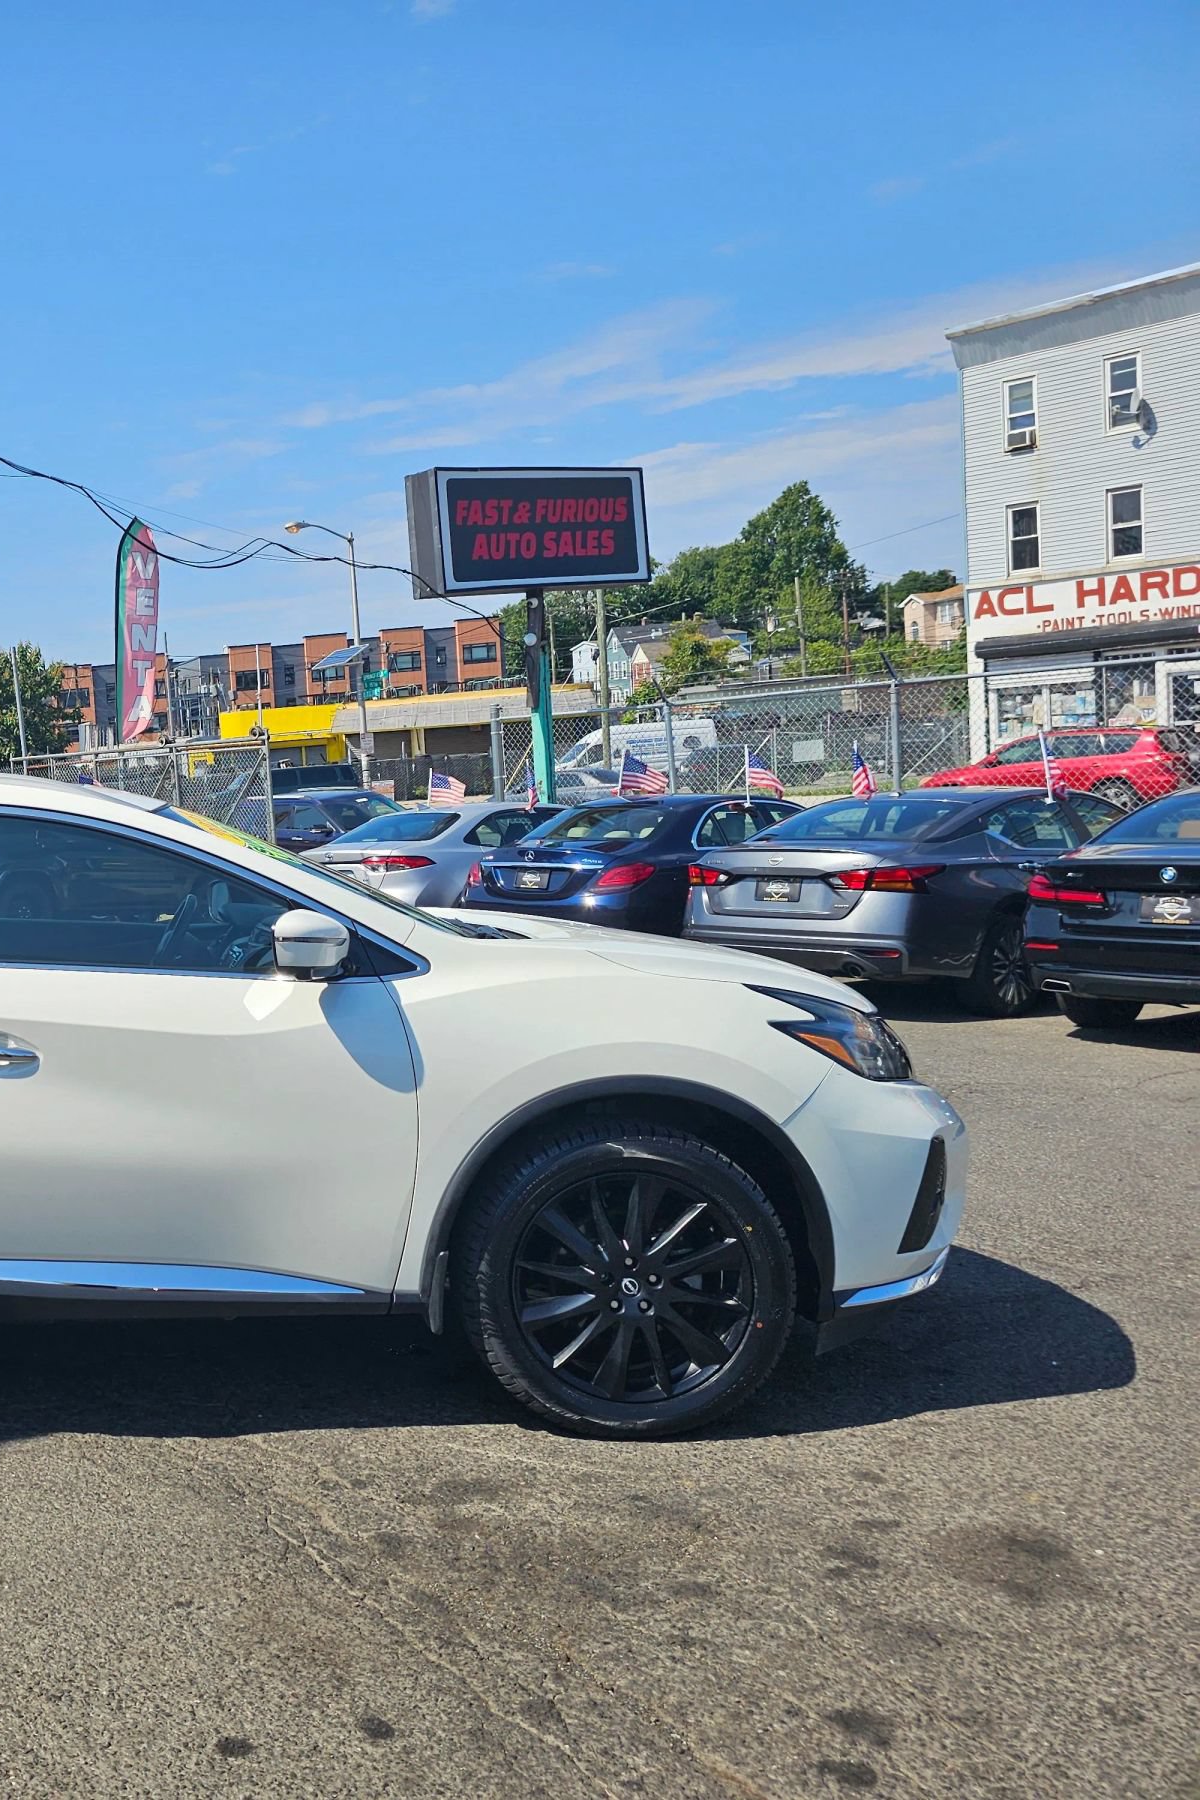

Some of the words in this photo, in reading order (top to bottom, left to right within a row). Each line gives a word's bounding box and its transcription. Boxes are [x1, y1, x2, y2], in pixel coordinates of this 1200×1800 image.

[455, 499, 512, 526] FAST
[513, 501, 531, 524] &
[535, 497, 628, 523] FURIOUS
[472, 532, 537, 561] AUTO
[543, 529, 615, 558] SALES
[974, 586, 1054, 619] ACL
[1075, 566, 1200, 609] HARD
[128, 551, 157, 722] VENTA
[1041, 616, 1085, 633] PAINT
[1096, 609, 1150, 626] TOOLS
